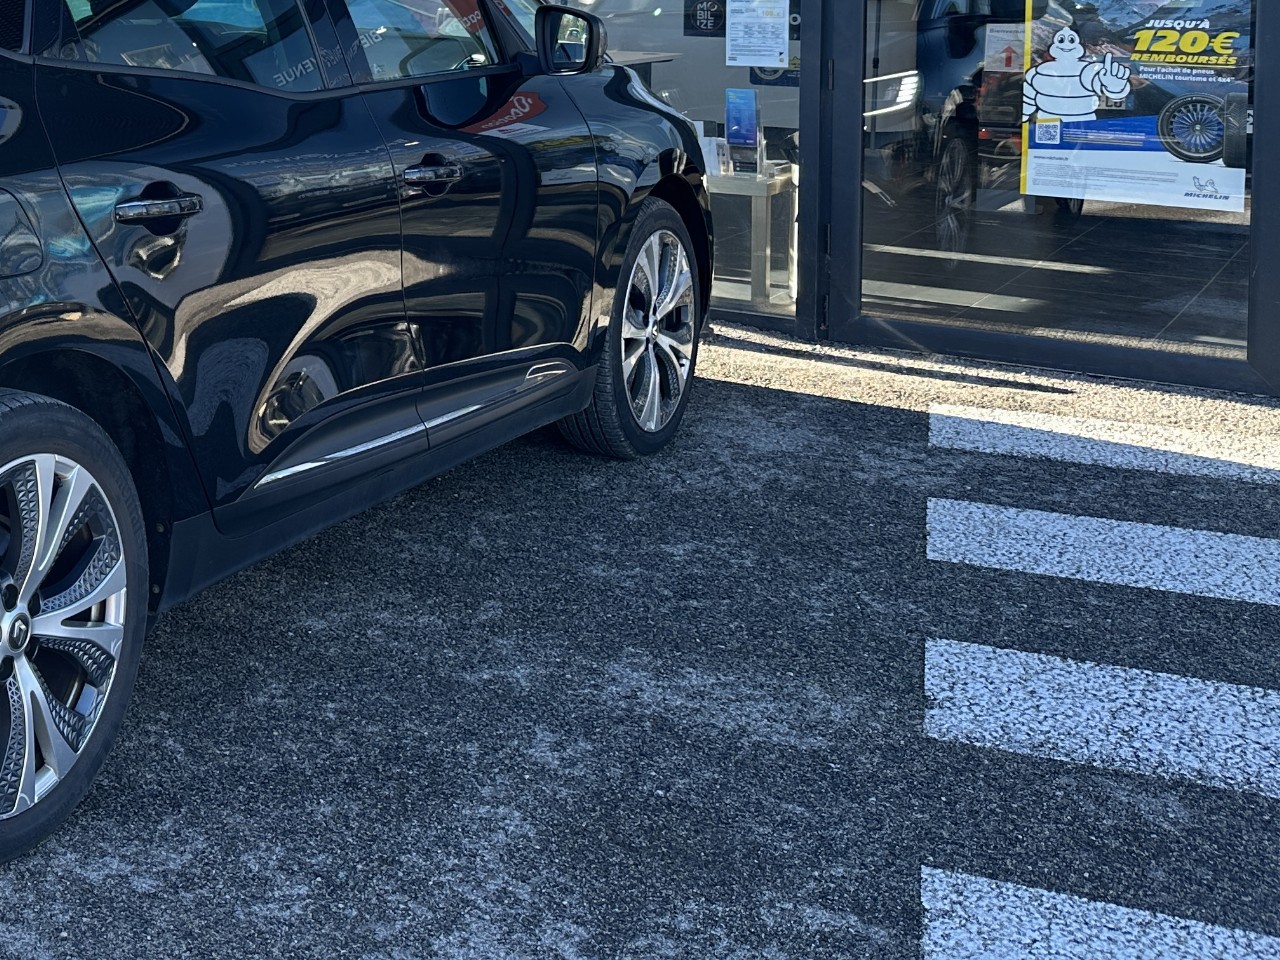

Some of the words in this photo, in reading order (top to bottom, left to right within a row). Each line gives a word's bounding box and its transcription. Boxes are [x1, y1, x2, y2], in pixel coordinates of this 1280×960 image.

[697, 11, 715, 20] BIL
[1133, 29, 1241, 54] 120€
[1130, 53, 1238, 65] REMBOURSÉS
[1184, 192, 1230, 201] MICHELIN
